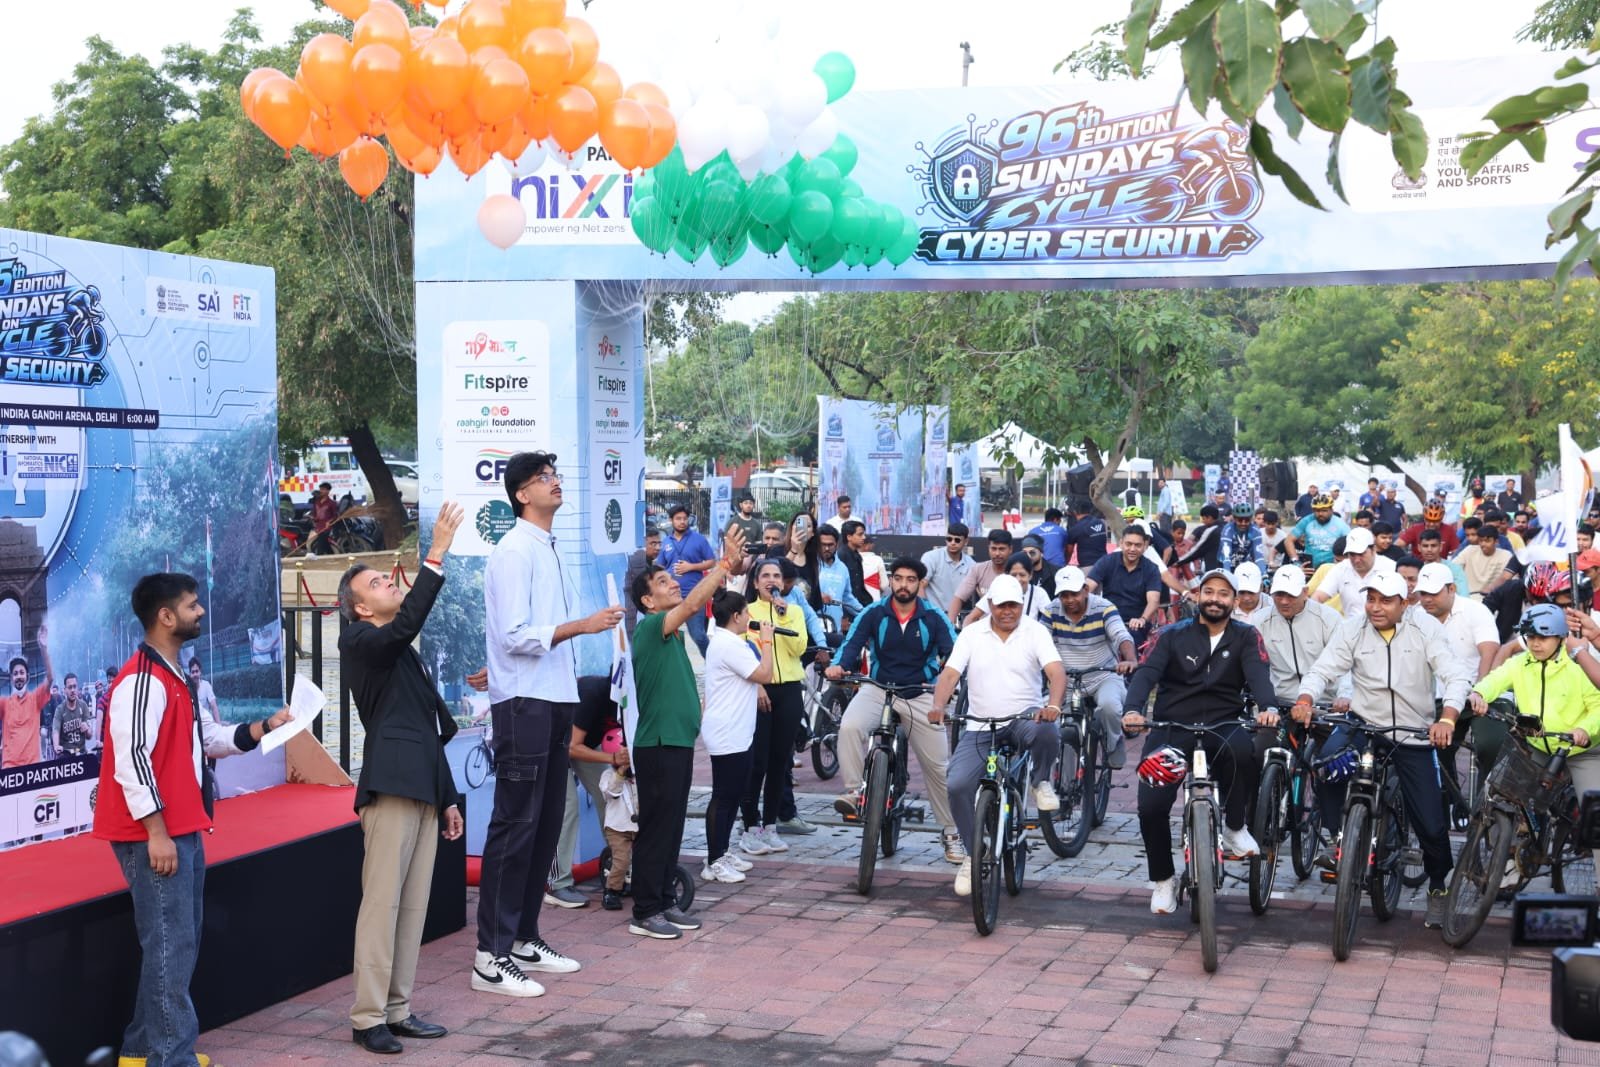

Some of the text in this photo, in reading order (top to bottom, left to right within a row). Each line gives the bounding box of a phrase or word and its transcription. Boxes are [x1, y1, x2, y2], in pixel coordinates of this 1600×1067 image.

[1078, 112, 1174, 148] EDITION
[998, 139, 1176, 197] SUNDAYS
[1437, 163, 1530, 178] YOUT AFFAIRS
[1054, 178, 1089, 197] ON
[1436, 175, 1512, 188] AND SPORTS
[984, 179, 1152, 230] CYCLE
[935, 226, 1234, 261] CYBER SECURITY
[13, 274, 64, 294] EDITION
[2, 318, 20, 331] ON
[233, 312, 252, 320] INDIA
[5, 357, 94, 385] SECURITY
[464, 374, 528, 393] Fitspire
[598, 376, 626, 395] Fitspire
[1, 407, 156, 425] INDIRA GANDHI ARENA, DELHI 6:00 AM
[457, 418, 536, 428] raahgiri foundation
[38, 435, 56, 444] WITH
[475, 460, 508, 480] CF
[604, 460, 621, 481] CFI
[26, 762, 84, 785] PARTNERS
[34, 801, 60, 822] CFI
